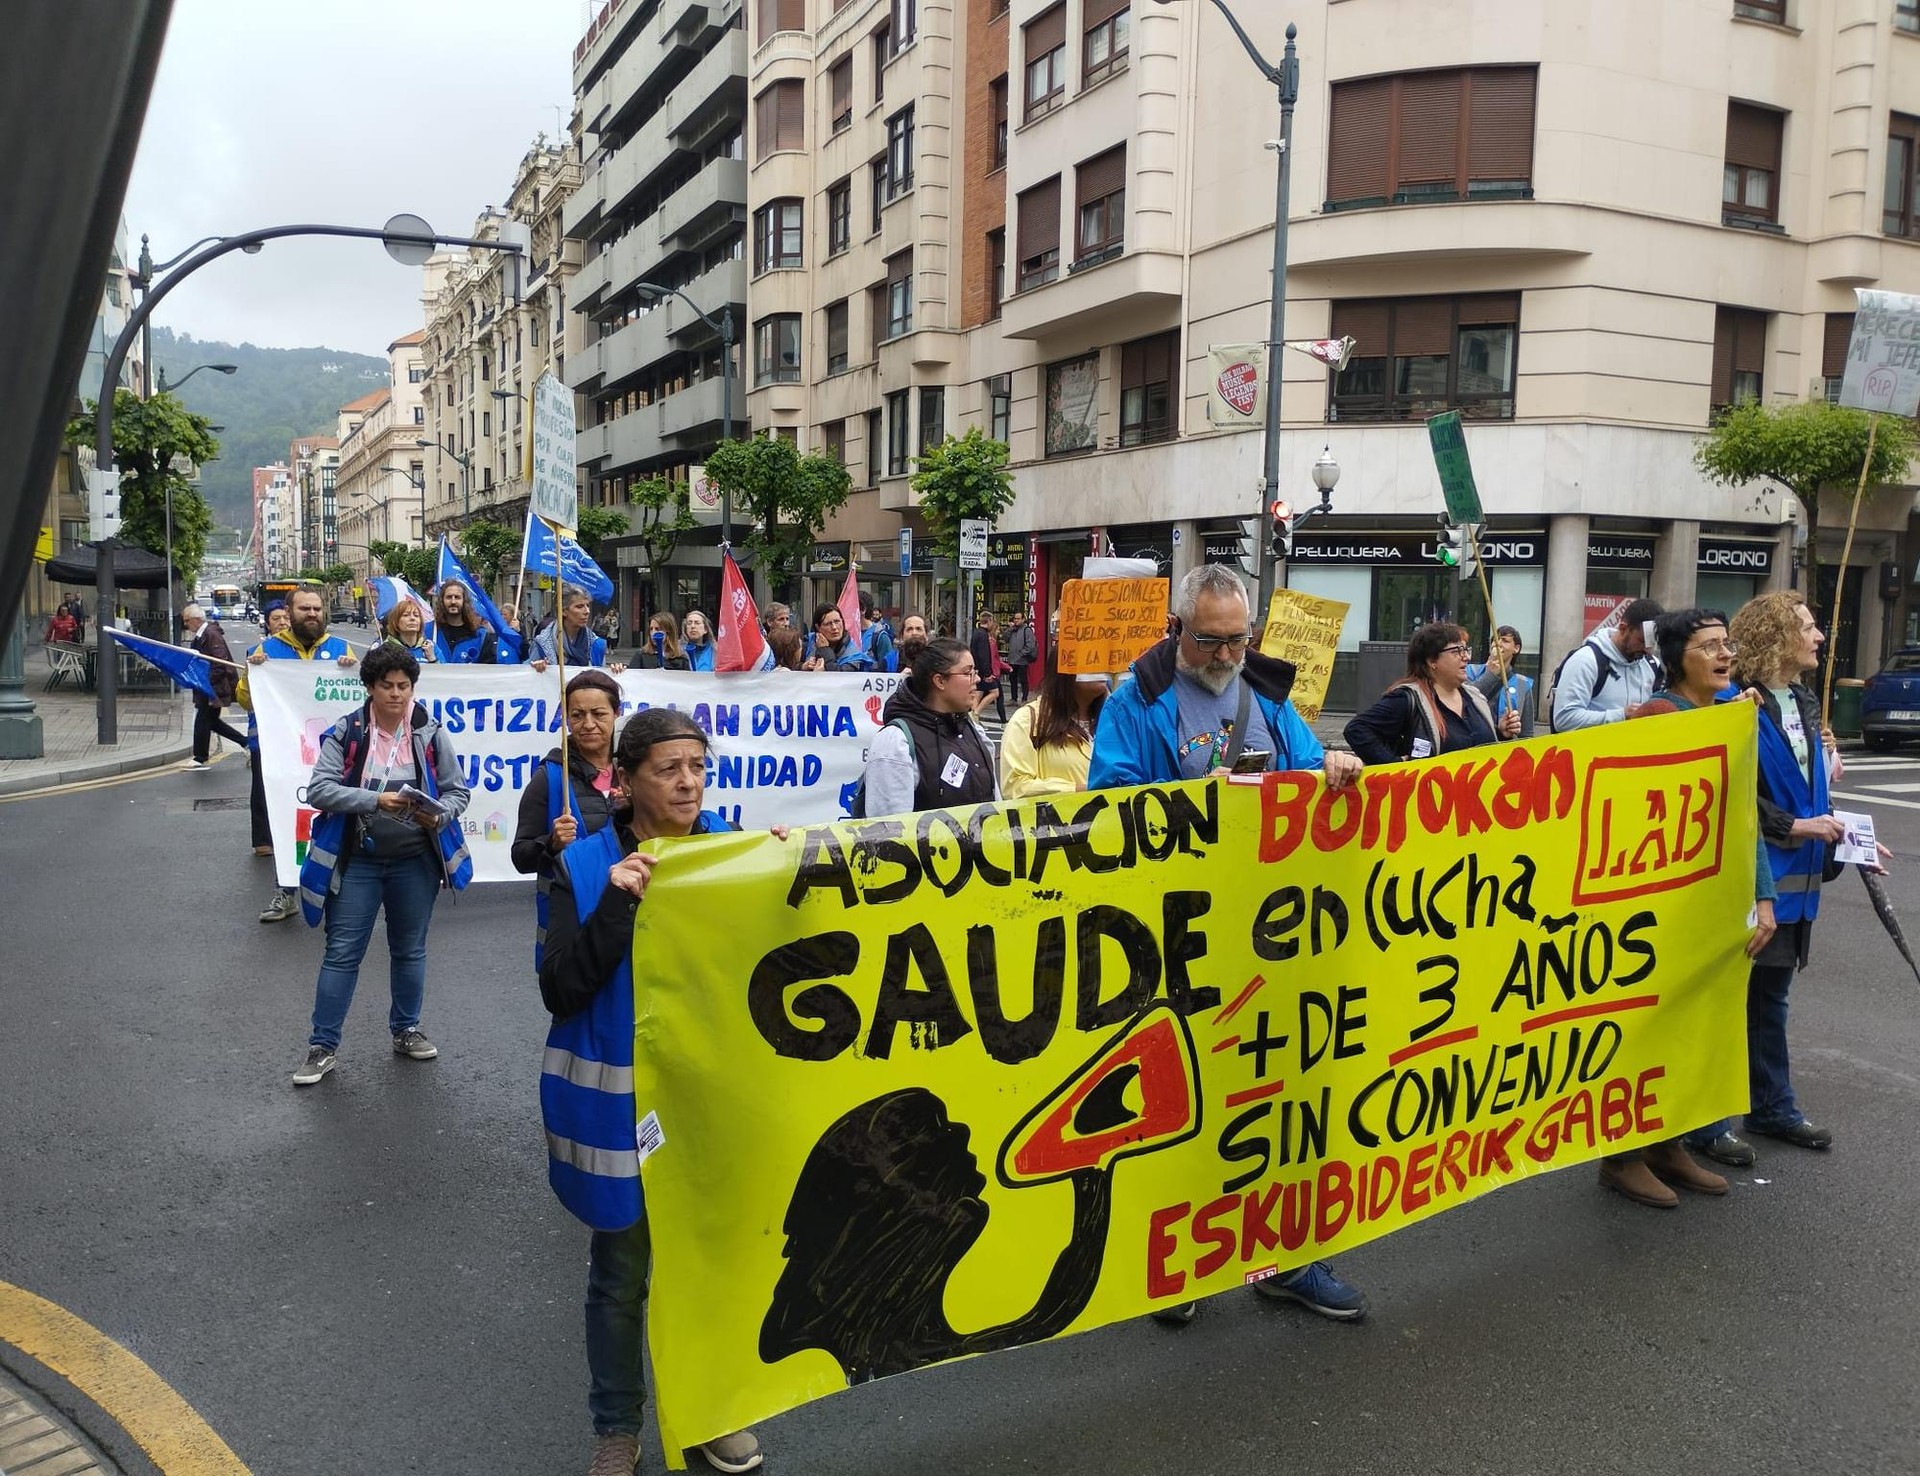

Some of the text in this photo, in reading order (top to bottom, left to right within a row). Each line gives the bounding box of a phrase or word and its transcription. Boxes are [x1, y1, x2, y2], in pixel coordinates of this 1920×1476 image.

[1222, 374, 1244, 391] MUSIC
[1224, 381, 1258, 400] LEGENDS
[1237, 392, 1255, 406] FEST
[1295, 546, 1402, 558] PELUQUERIA
[1421, 542, 1534, 559] LOÑO
[1587, 546, 1651, 559] PELUQUERIA
[1029, 538, 1037, 634] THOMAS
[1061, 581, 1168, 605] PROFESIONALES
[1066, 606, 1160, 622] DEL SIGLO XXI
[1061, 649, 1078, 667] DE
[1085, 650, 1101, 666] LA
[1284, 643, 1314, 661] PERO
[315, 676, 365, 687] Asociacio
[752, 704, 857, 737] DUINA
[1588, 777, 1715, 881] LAB
[786, 781, 1219, 910] ASOCIACION
[1252, 853, 1537, 962] en lucha
[747, 890, 1222, 1065] GAUDE
[1300, 986, 1368, 1075] DE
[1408, 955, 1460, 1044] 3
[1491, 910, 1659, 1014] AÑOS
[1217, 1020, 1623, 1194] SIN CONVENIO
[1146, 1065, 1667, 1299] ESKUBIDERIK GABE
